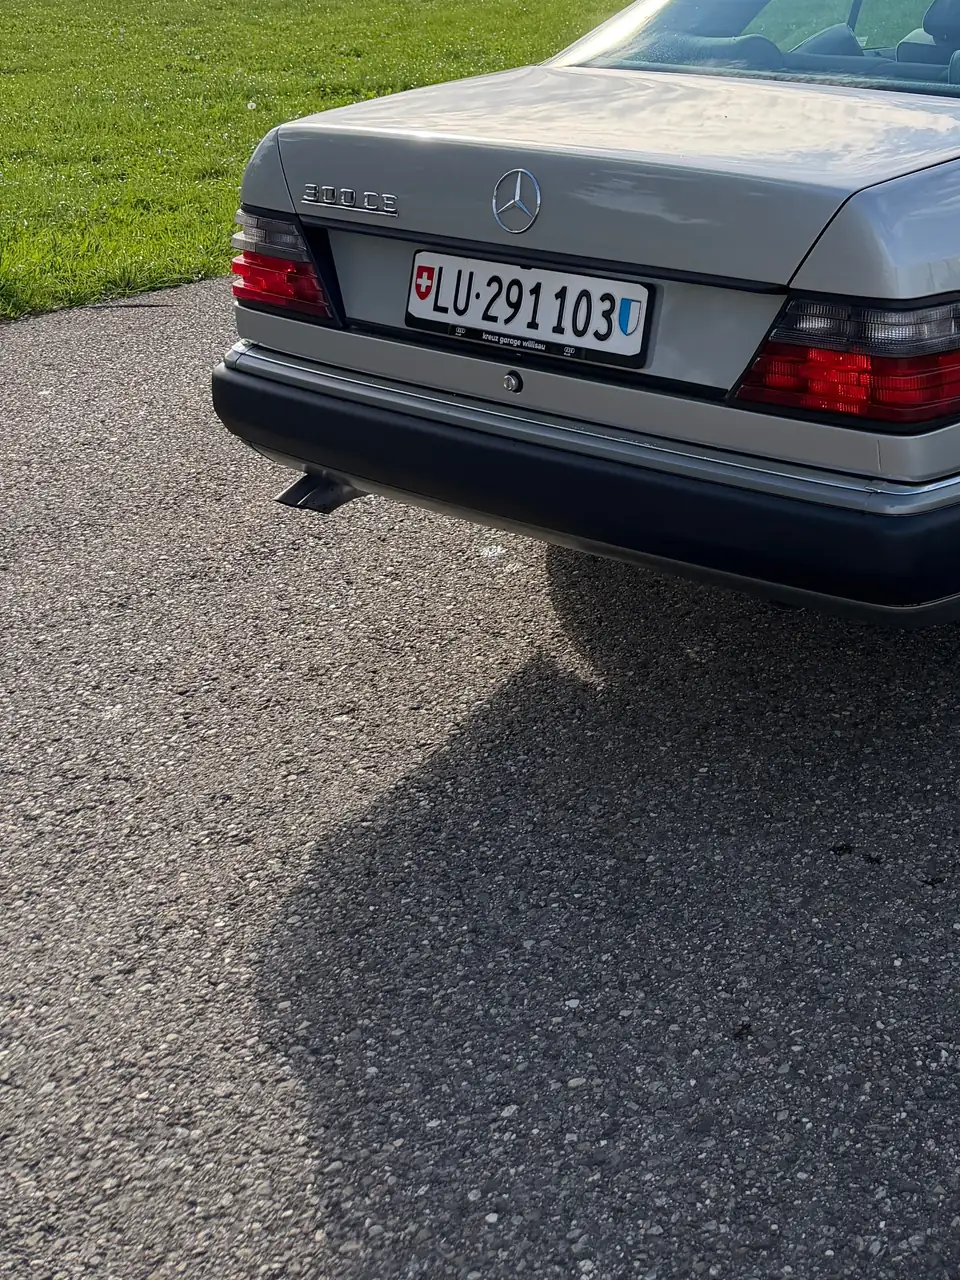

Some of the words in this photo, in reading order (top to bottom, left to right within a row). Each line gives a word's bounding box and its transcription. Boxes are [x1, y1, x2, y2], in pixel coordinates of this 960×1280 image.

[303, 183, 356, 206] 300
[363, 191, 398, 212] CE
[482, 332, 499, 342] kreuz
[499, 337, 521, 346] garage
[522, 340, 546, 350] willisau
